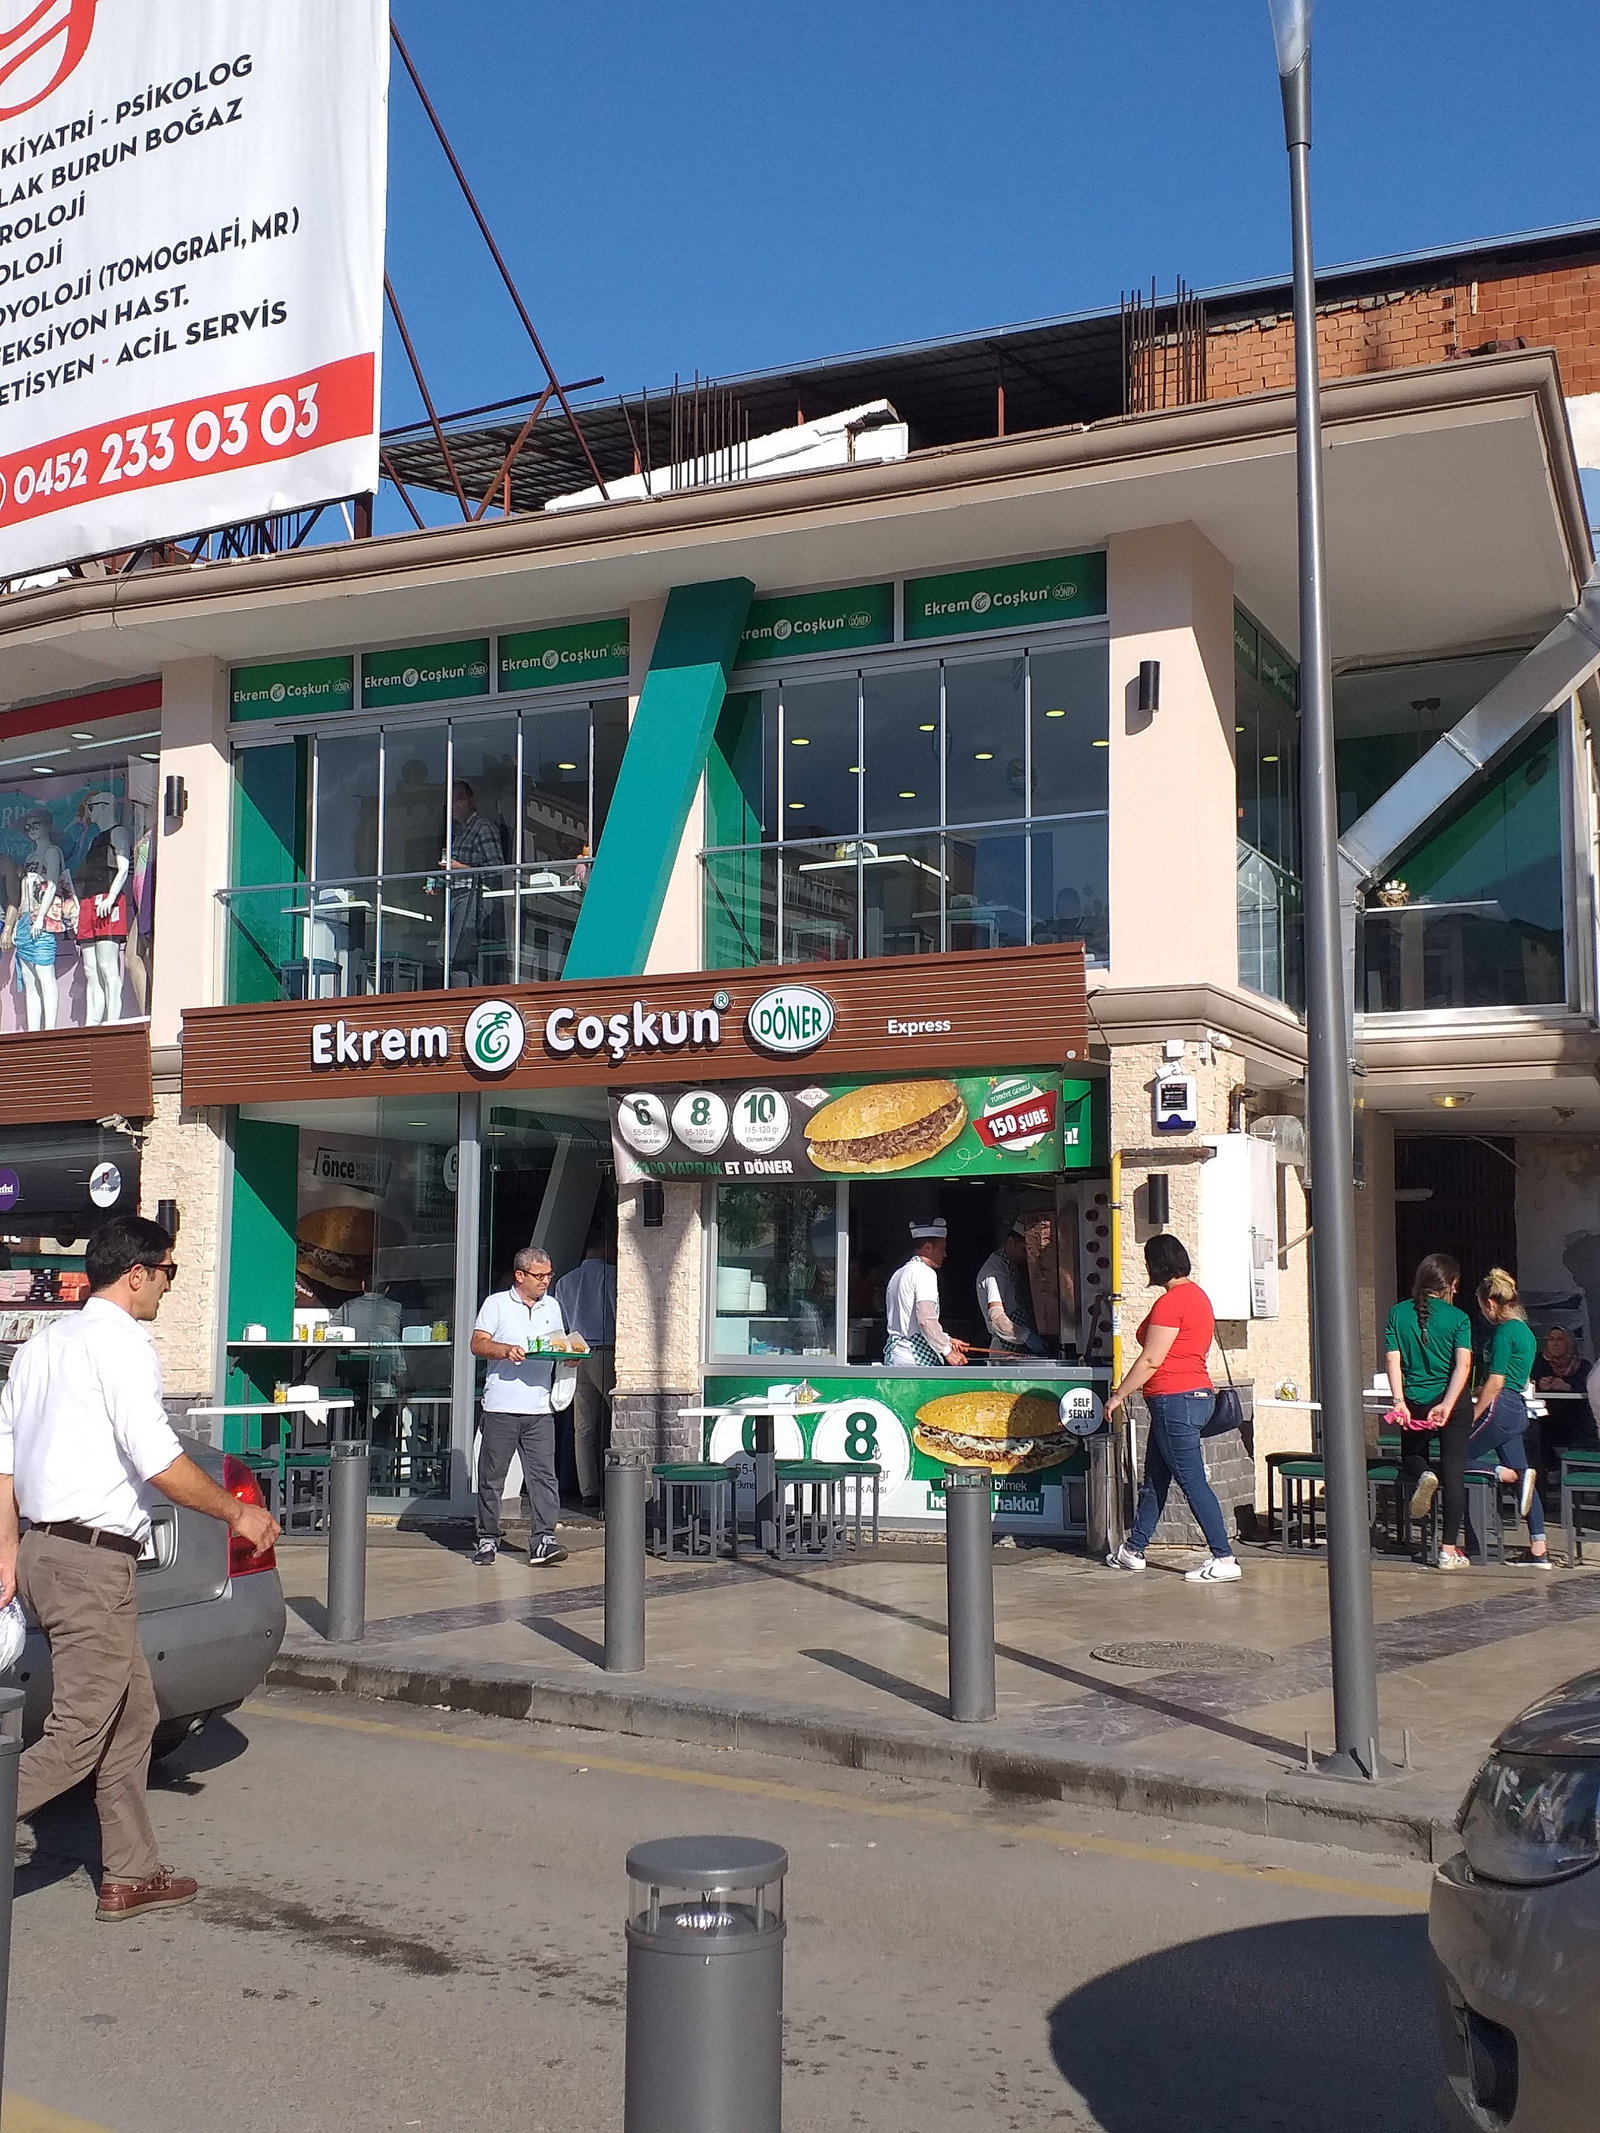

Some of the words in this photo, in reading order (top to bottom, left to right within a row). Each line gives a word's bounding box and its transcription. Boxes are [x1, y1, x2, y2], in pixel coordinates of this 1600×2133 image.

[1, 109, 94, 170] KİYATRİ
[115, 54, 253, 125] PSİKOLOG
[51, 135, 138, 190] BURUN
[145, 96, 244, 153] BOĞAZ
[0, 189, 86, 247] ROLOJİ
[98, 216, 248, 292] (TOMOGRAFİ,
[0, 308, 107, 367] EKSİYON
[115, 283, 190, 326] HAST.
[0, 353, 95, 407] ETİSYEN
[116, 327, 178, 367] ACİL
[185, 298, 288, 346] SERVİS
[13, 447, 89, 505] 0452
[98, 418, 176, 485] 233
[185, 401, 250, 463] 03
[260, 382, 320, 447] 03
[924, 600, 970, 616] Ekrem
[993, 588, 1048, 607] Coşkun
[793, 617, 844, 635] Coşkun
[502, 659, 541, 672] Ekrem
[560, 648, 607, 664] Coşkun
[364, 676, 401, 689] Ekrem
[420, 667, 465, 683] Coşkun
[233, 690, 269, 703] Ekrem
[286, 683, 330, 698] Coşkun
[311, 1019, 449, 1064] Ekrem
[545, 1000, 721, 1060] Coşkun
[760, 997, 823, 1041] DÖNER
[886, 1018, 952, 1037] Express
[987, 1113, 1017, 1139] 150
[1018, 1108, 1050, 1133] ŞUBE
[321, 1154, 356, 1180] önce
[724, 1161, 741, 1175] ET
[744, 1158, 794, 1175] DÖNER
[1068, 1407, 1095, 1420] SERVİS
[1073, 1398, 1091, 1408] SELF
[994, 1479, 1028, 1492] bilmek
[994, 1495, 1040, 1513] hakkı!
